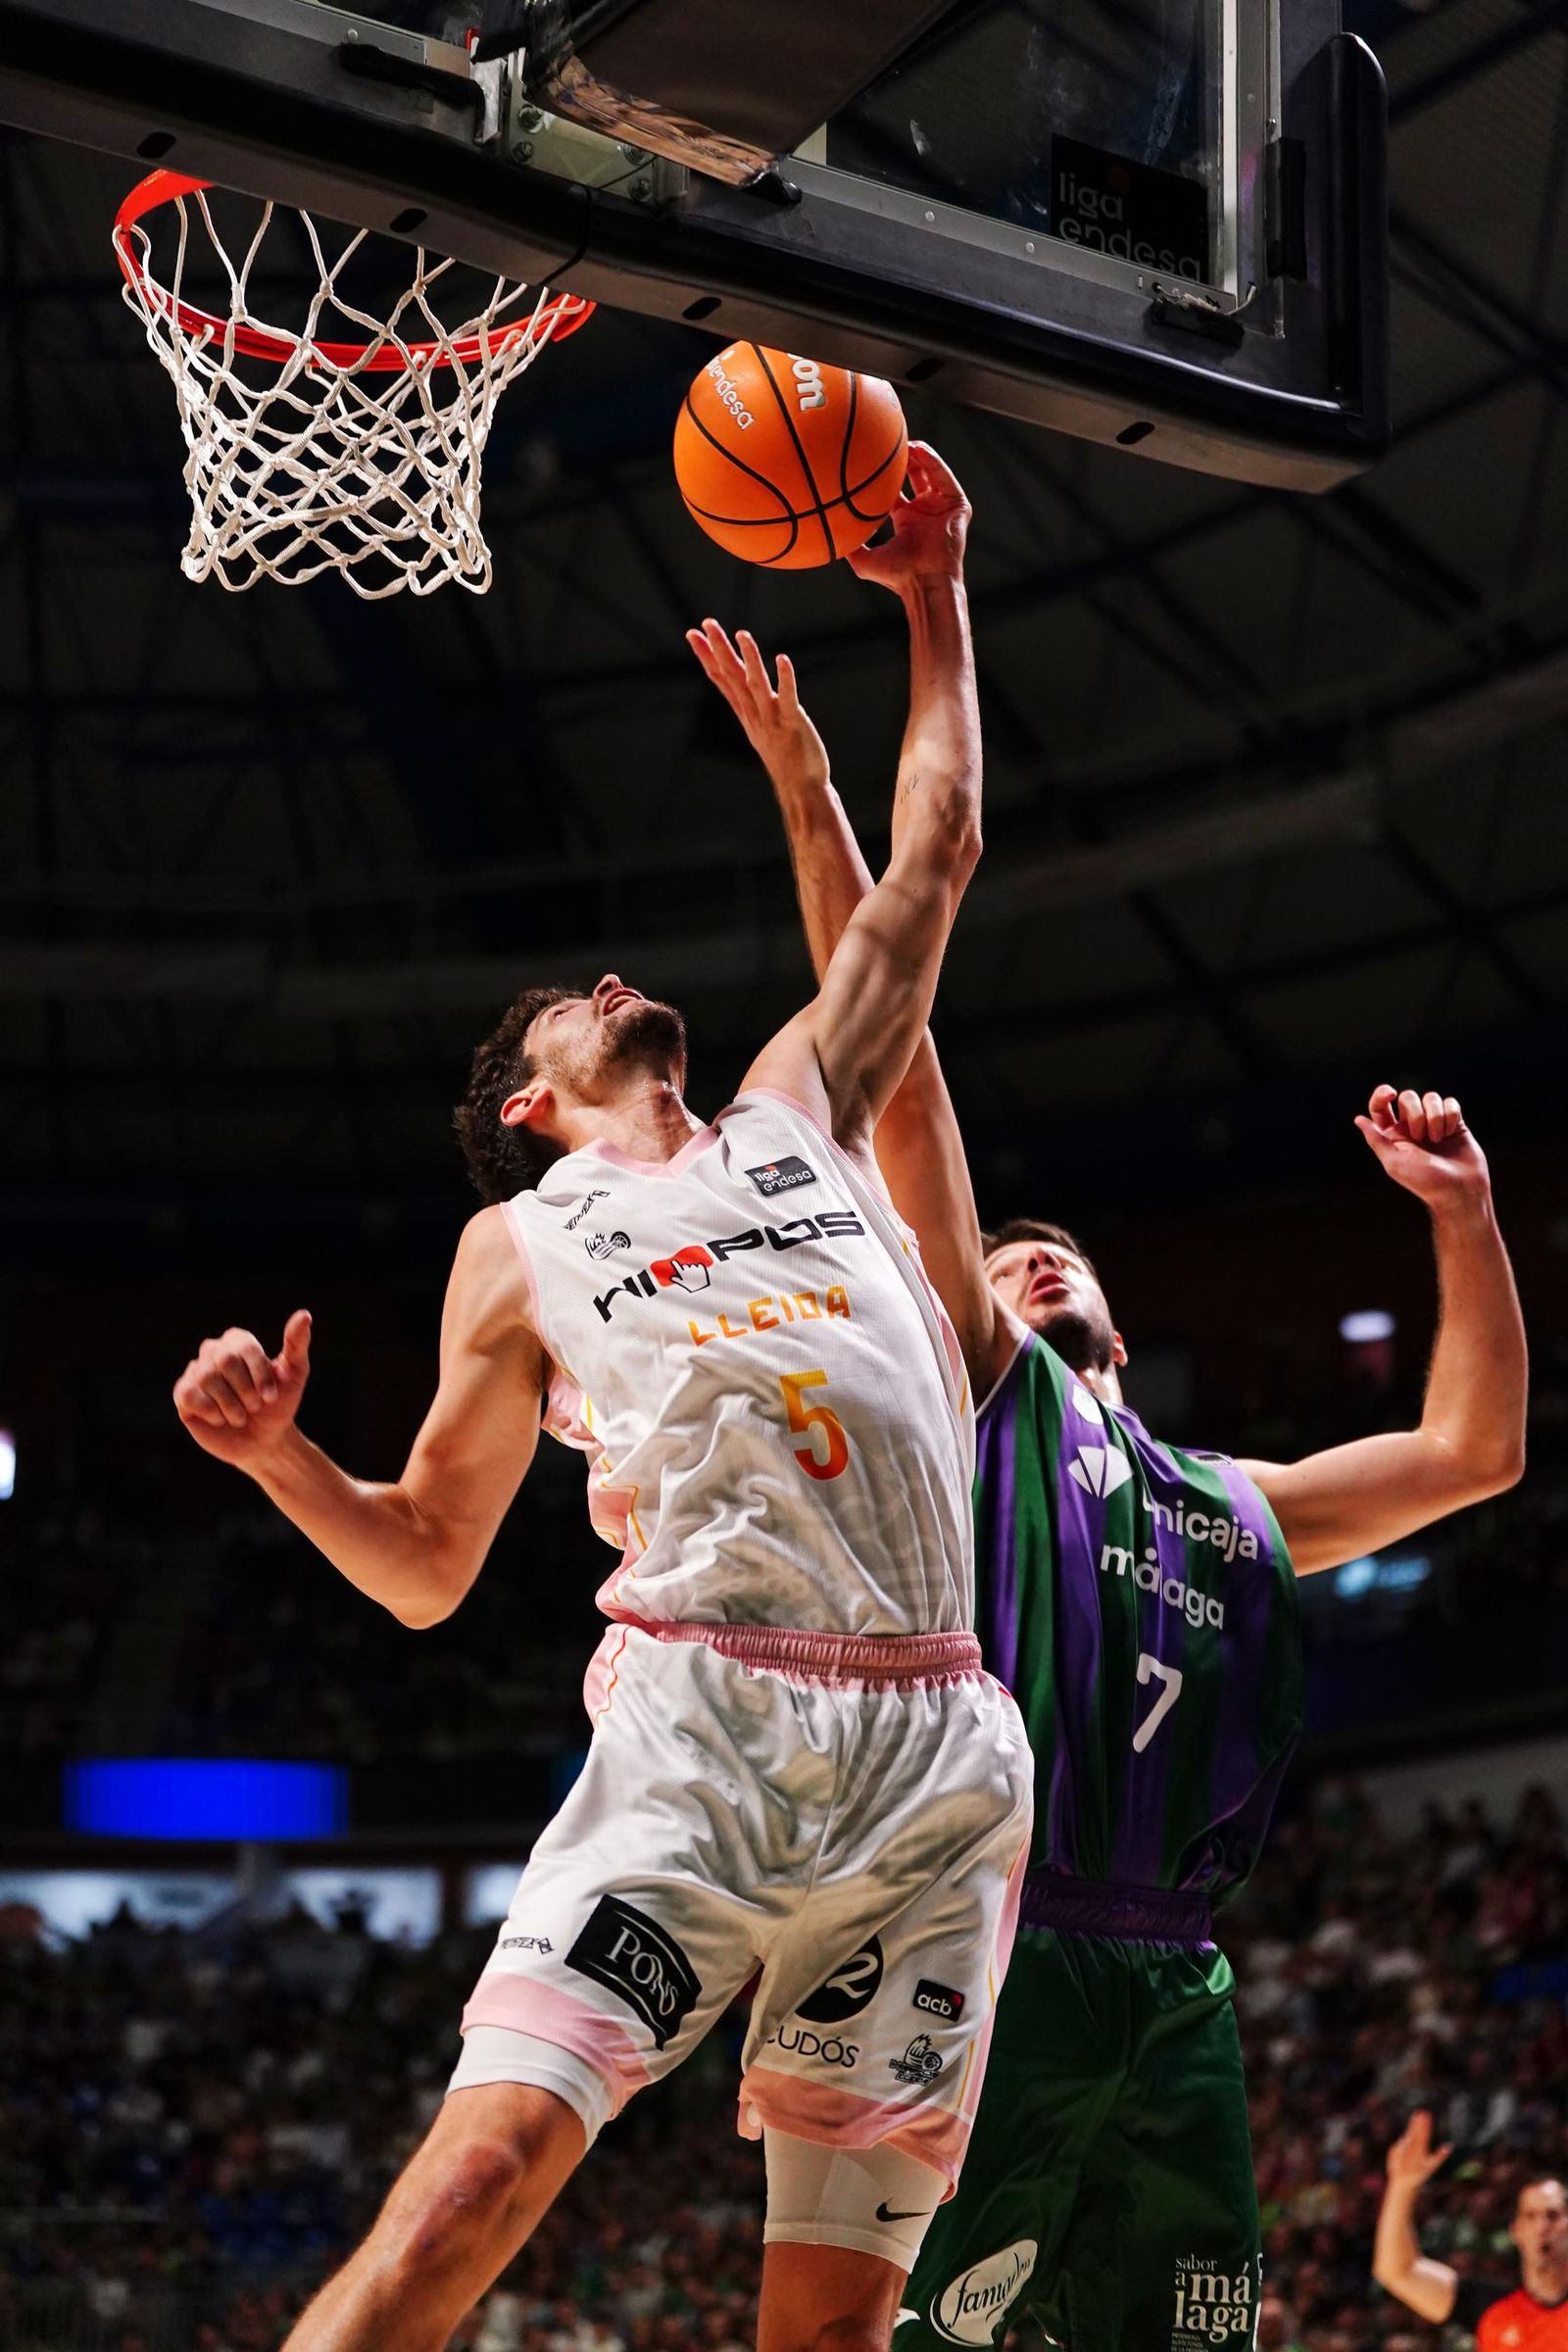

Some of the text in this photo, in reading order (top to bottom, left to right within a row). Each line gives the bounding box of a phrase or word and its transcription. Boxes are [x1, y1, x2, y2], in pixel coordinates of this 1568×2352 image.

[1059, 171, 1123, 221] liga
[1059, 217, 1200, 282] endesa
[709, 365, 755, 429] endesa
[787, 353, 826, 412] on
[754, 1169, 781, 1182] liga
[763, 1169, 812, 1192] endesa
[688, 1284, 852, 1347] LLEIDA
[778, 1368, 851, 1481] 5
[1132, 1652, 1183, 1753] 7
[605, 1926, 680, 2016] PONS
[917, 1994, 953, 2016] acb
[767, 2025, 860, 2068] UDÓS
[1174, 2272, 1187, 2286] a
[1189, 2261, 1252, 2305] má
[1175, 2253, 1218, 2271] sabor
[1173, 2289, 1250, 2344] laga
